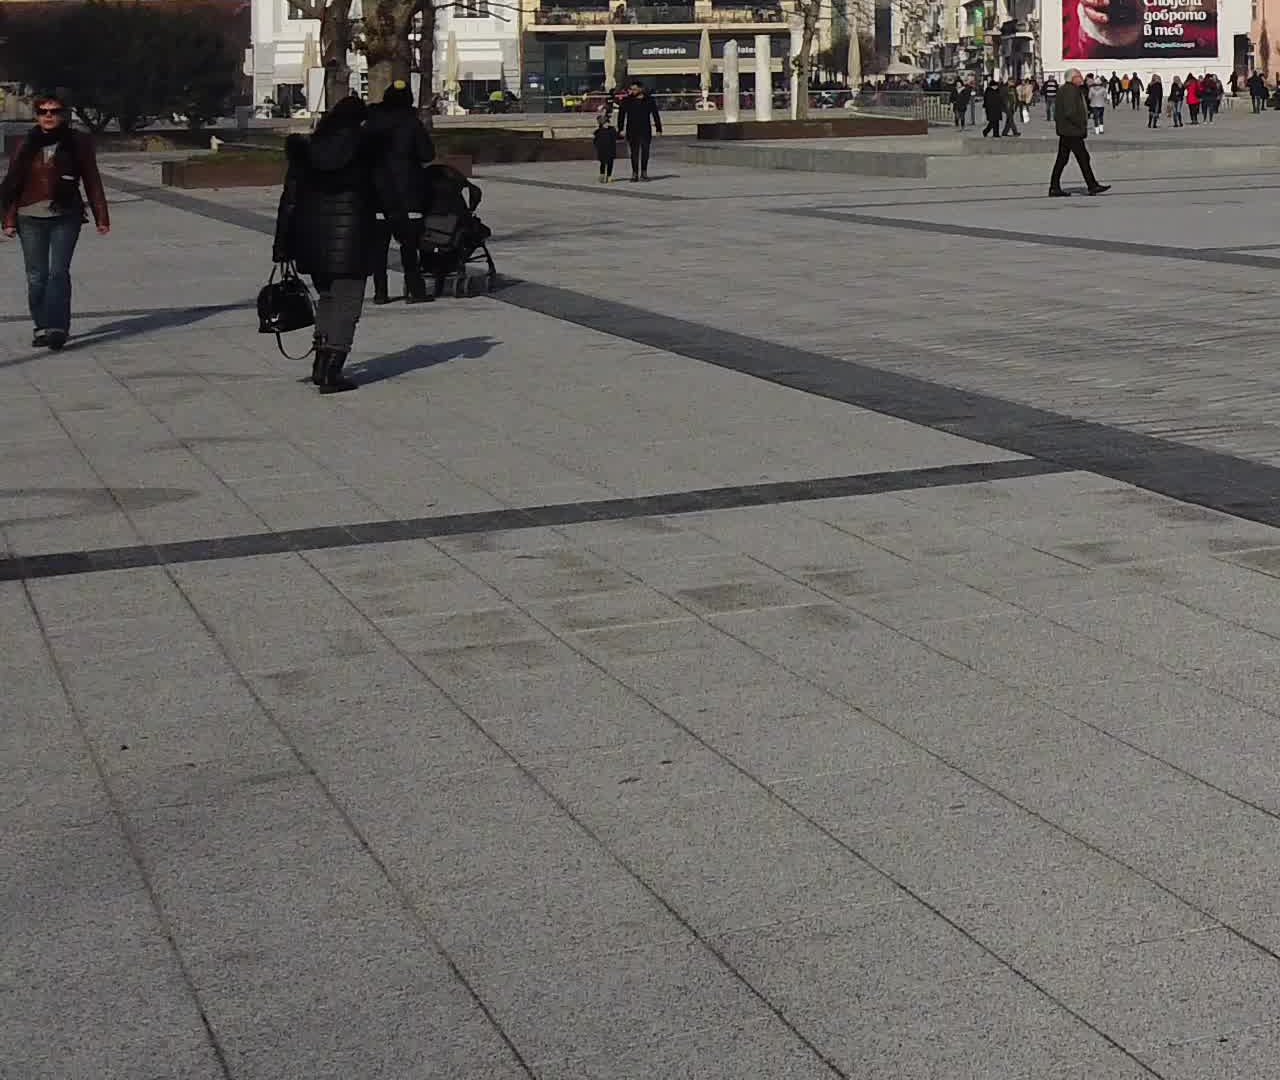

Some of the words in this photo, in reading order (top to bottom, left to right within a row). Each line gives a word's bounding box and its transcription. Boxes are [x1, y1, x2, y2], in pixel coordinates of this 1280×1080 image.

[1143, 9, 1207, 23] доброто
[1154, 24, 1184, 36] теб
[642, 47, 687, 55] caffetteria
